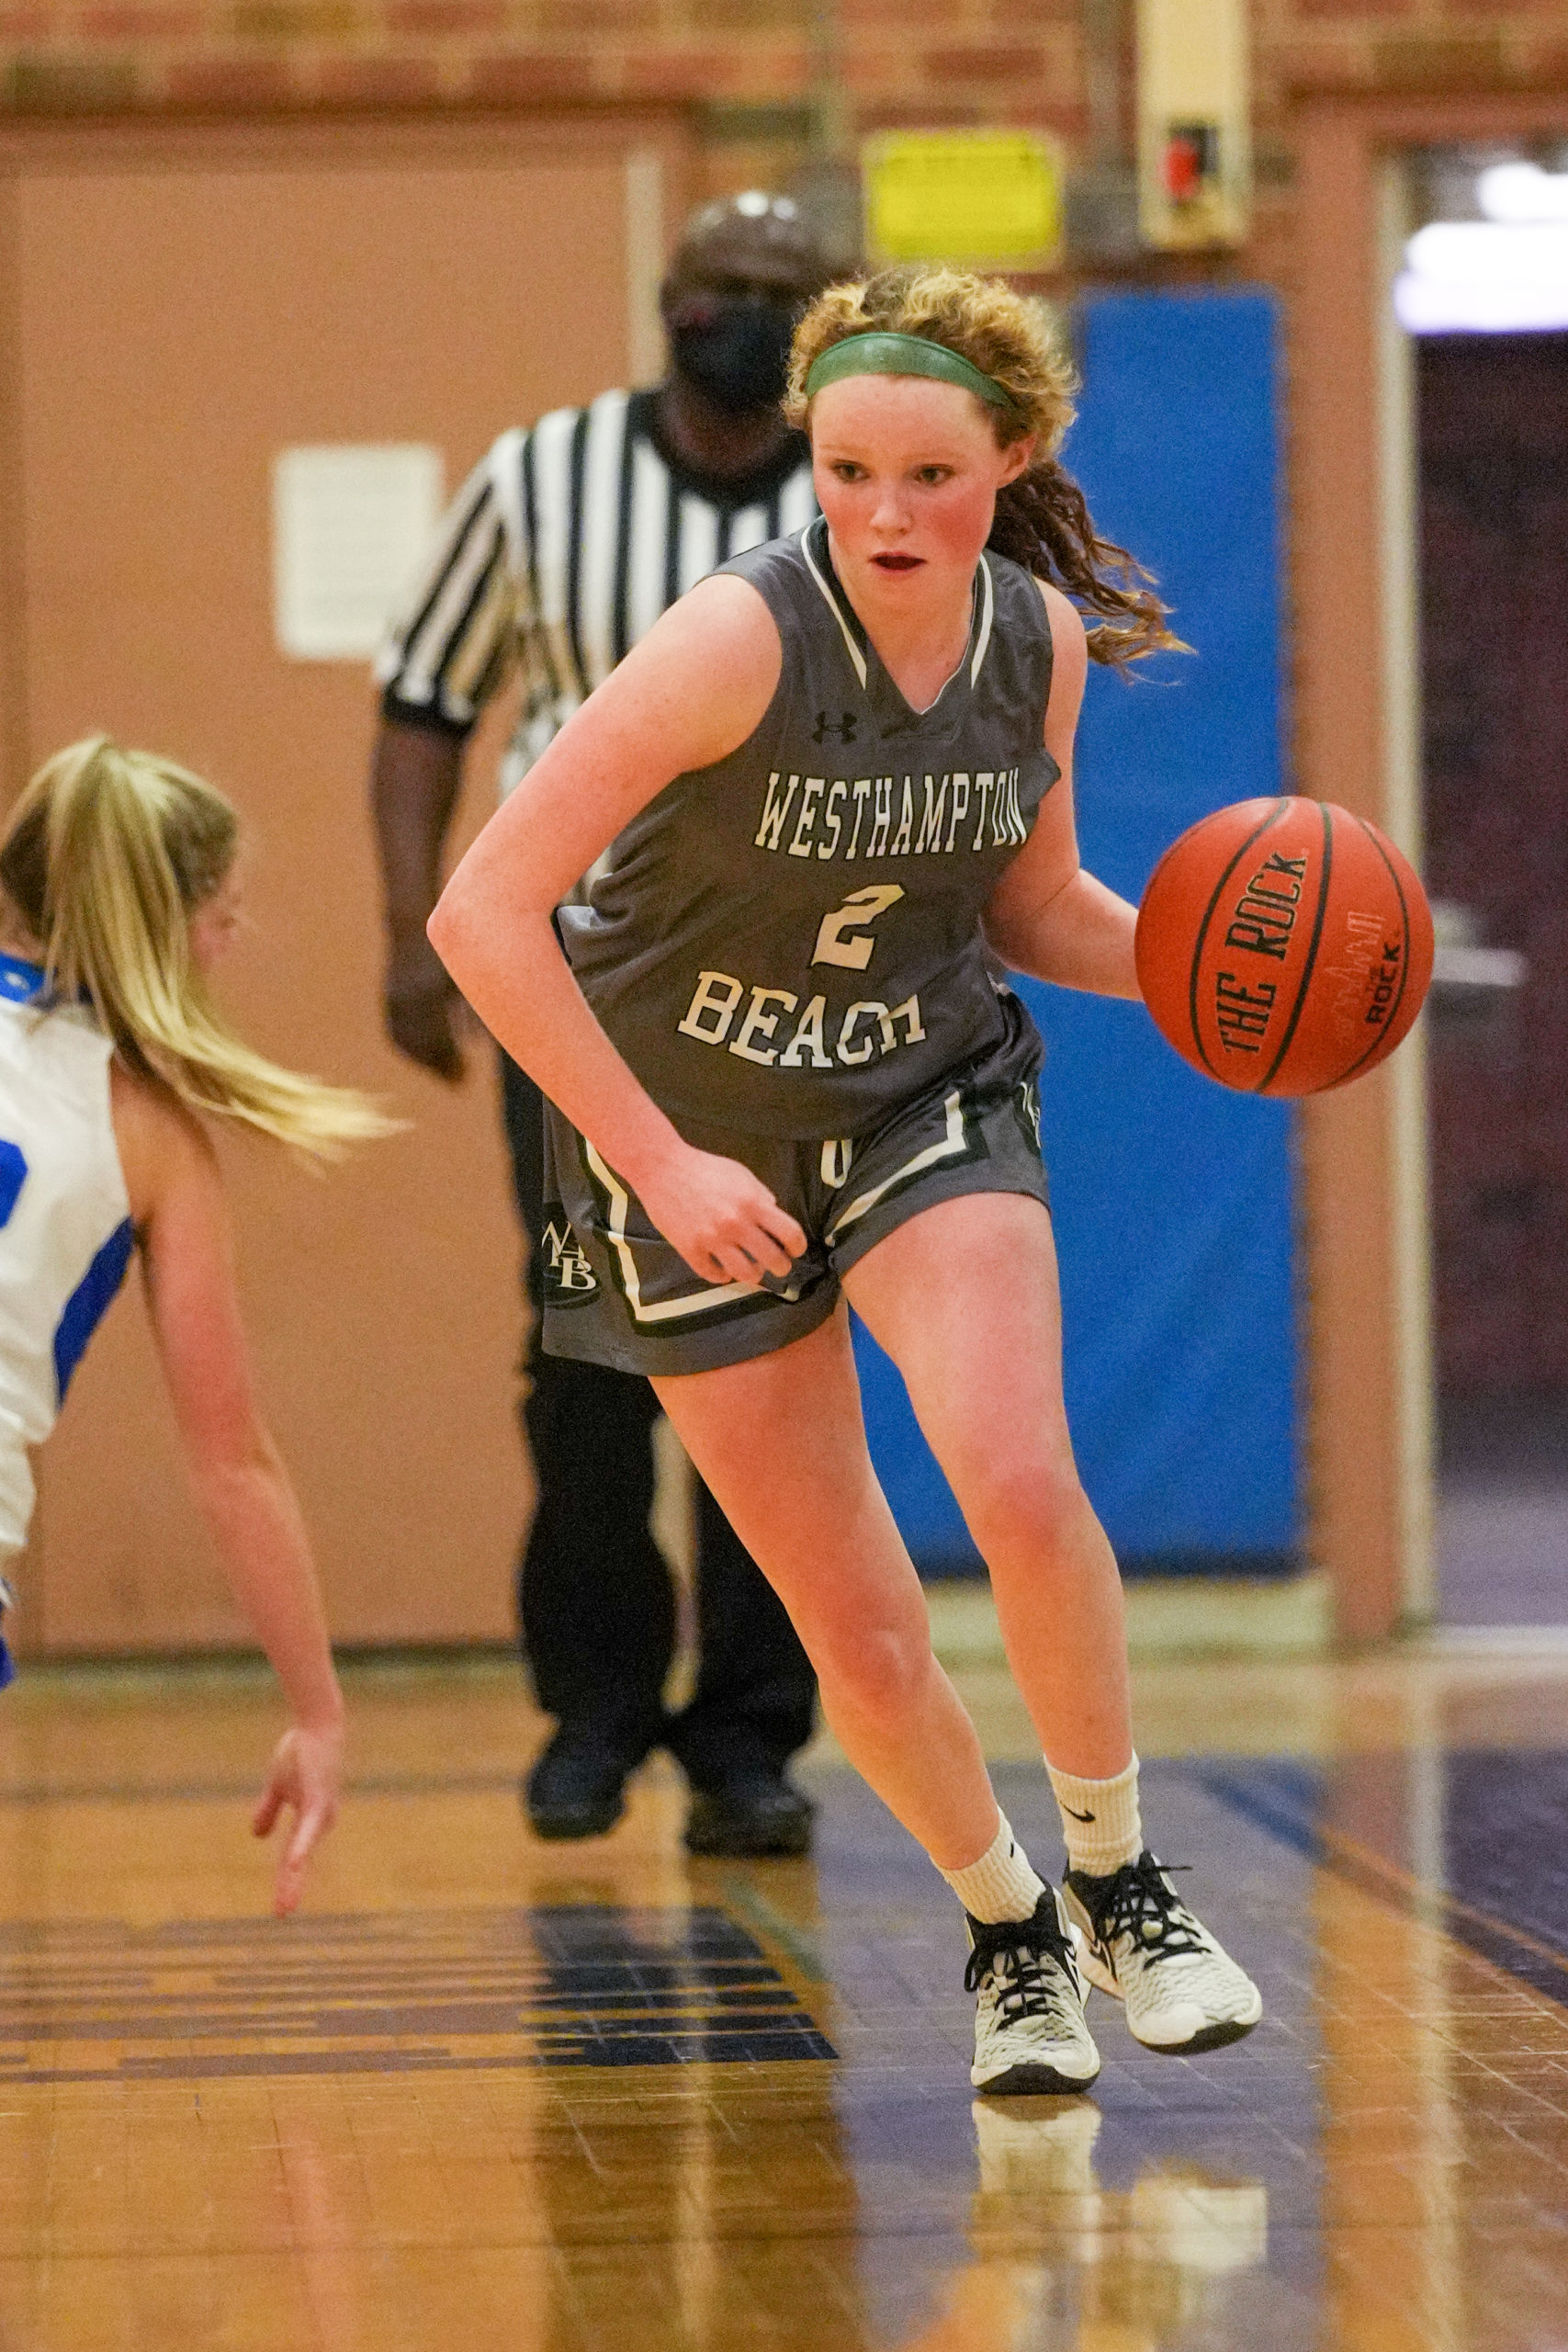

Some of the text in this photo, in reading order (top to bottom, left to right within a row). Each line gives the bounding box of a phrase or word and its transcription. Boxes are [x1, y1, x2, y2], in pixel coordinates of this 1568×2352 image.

[753, 766, 1027, 860] WESTHAMPTON
[810, 884, 906, 970] 2
[1215, 851, 1307, 1054] THE ROCK
[1365, 941, 1402, 1025] ROCK
